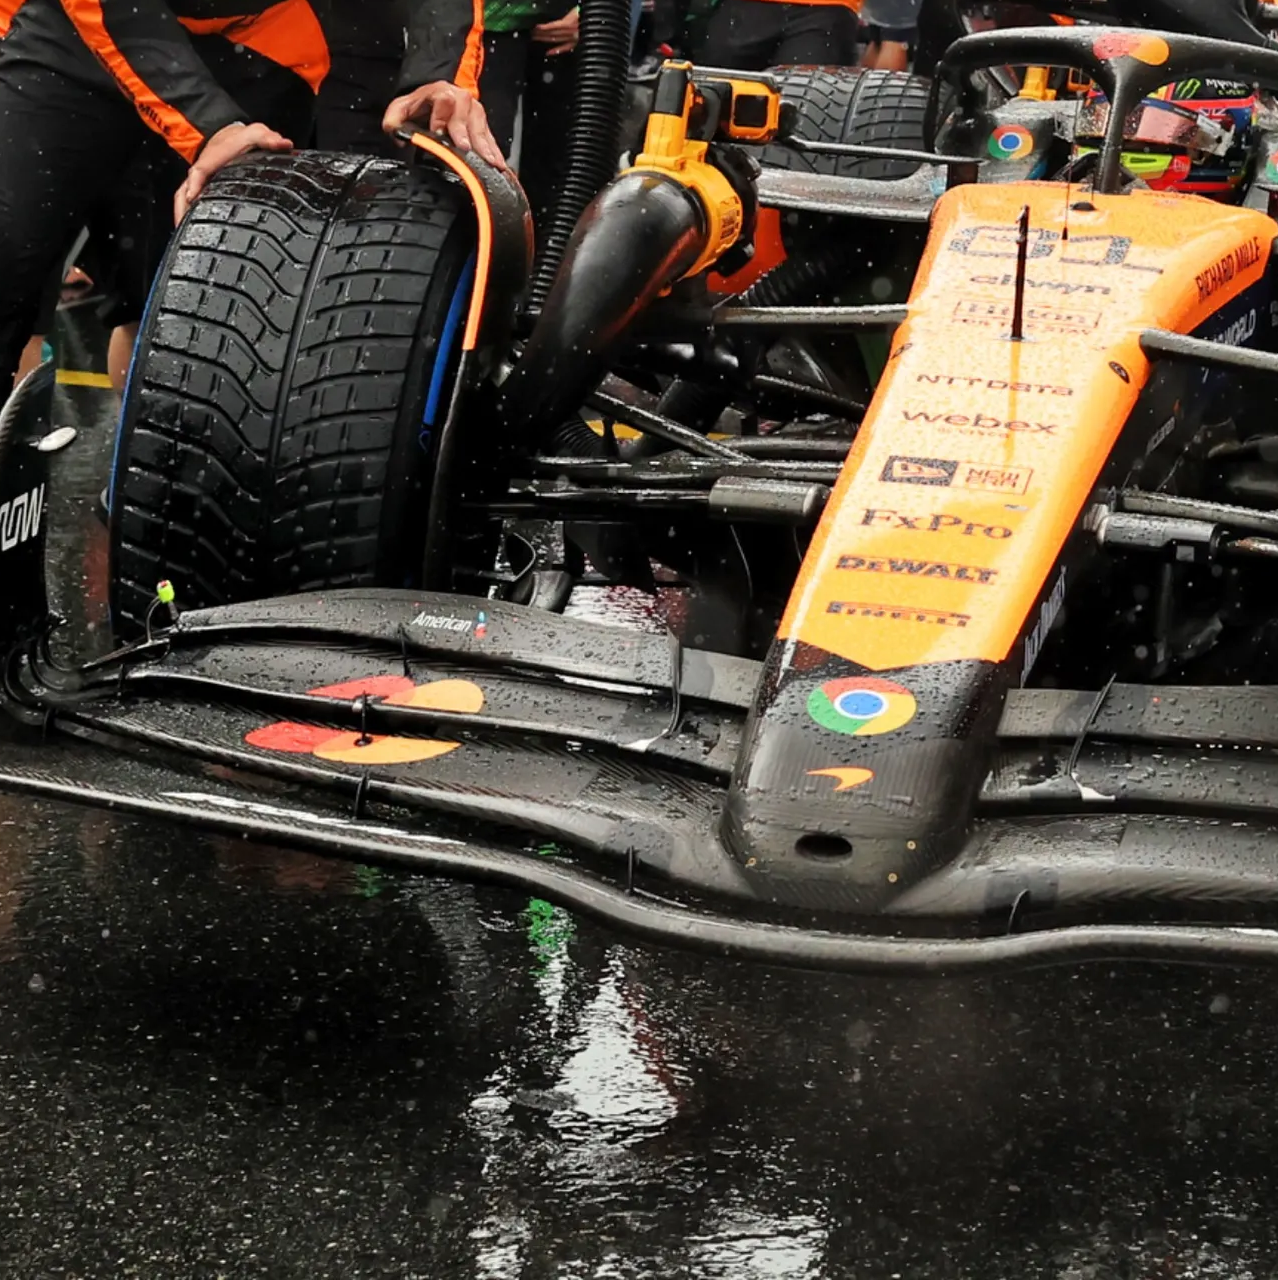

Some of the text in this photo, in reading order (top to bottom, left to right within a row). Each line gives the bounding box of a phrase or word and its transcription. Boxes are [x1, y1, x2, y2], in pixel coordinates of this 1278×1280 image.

[1194, 236, 1262, 304] RICHARD MILLE
[901, 409, 1059, 435] webex
[860, 507, 1014, 541] FxPro
[411, 609, 472, 633] American
[826, 601, 972, 628] PIRELLI
